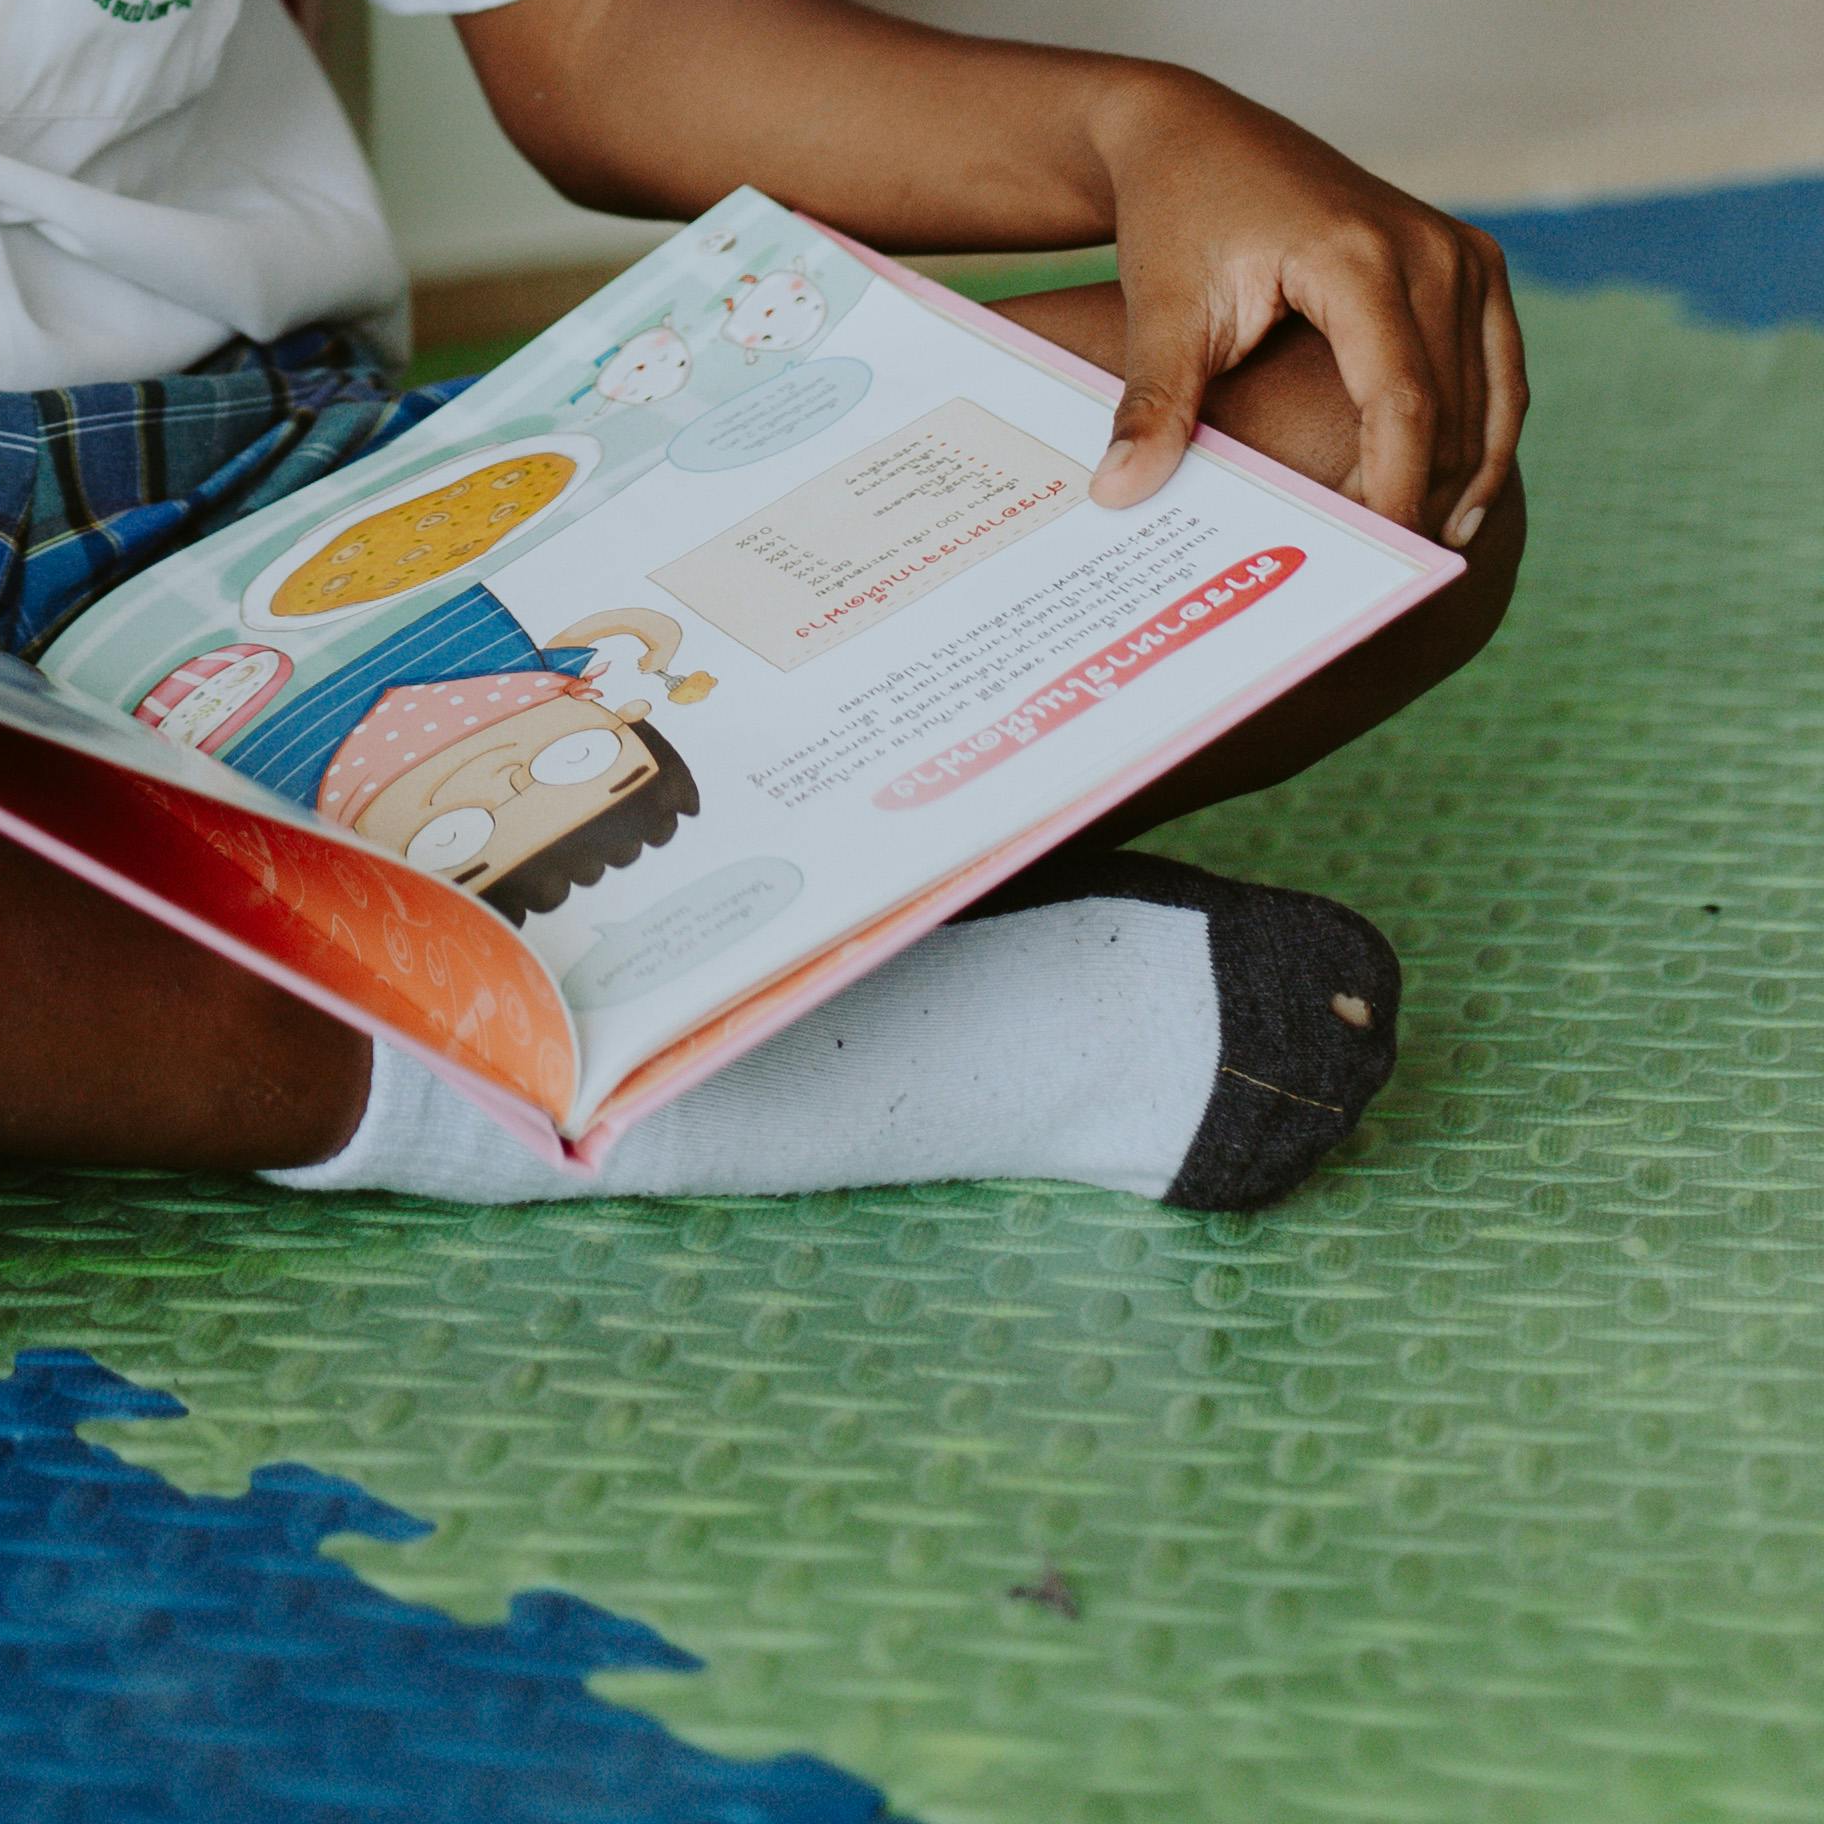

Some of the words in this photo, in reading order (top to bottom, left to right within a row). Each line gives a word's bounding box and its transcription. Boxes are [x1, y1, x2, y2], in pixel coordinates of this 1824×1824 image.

[932, 509, 966, 529] 100
[887, 552, 1289, 799] สารอาหารในเห็ดฟาง
